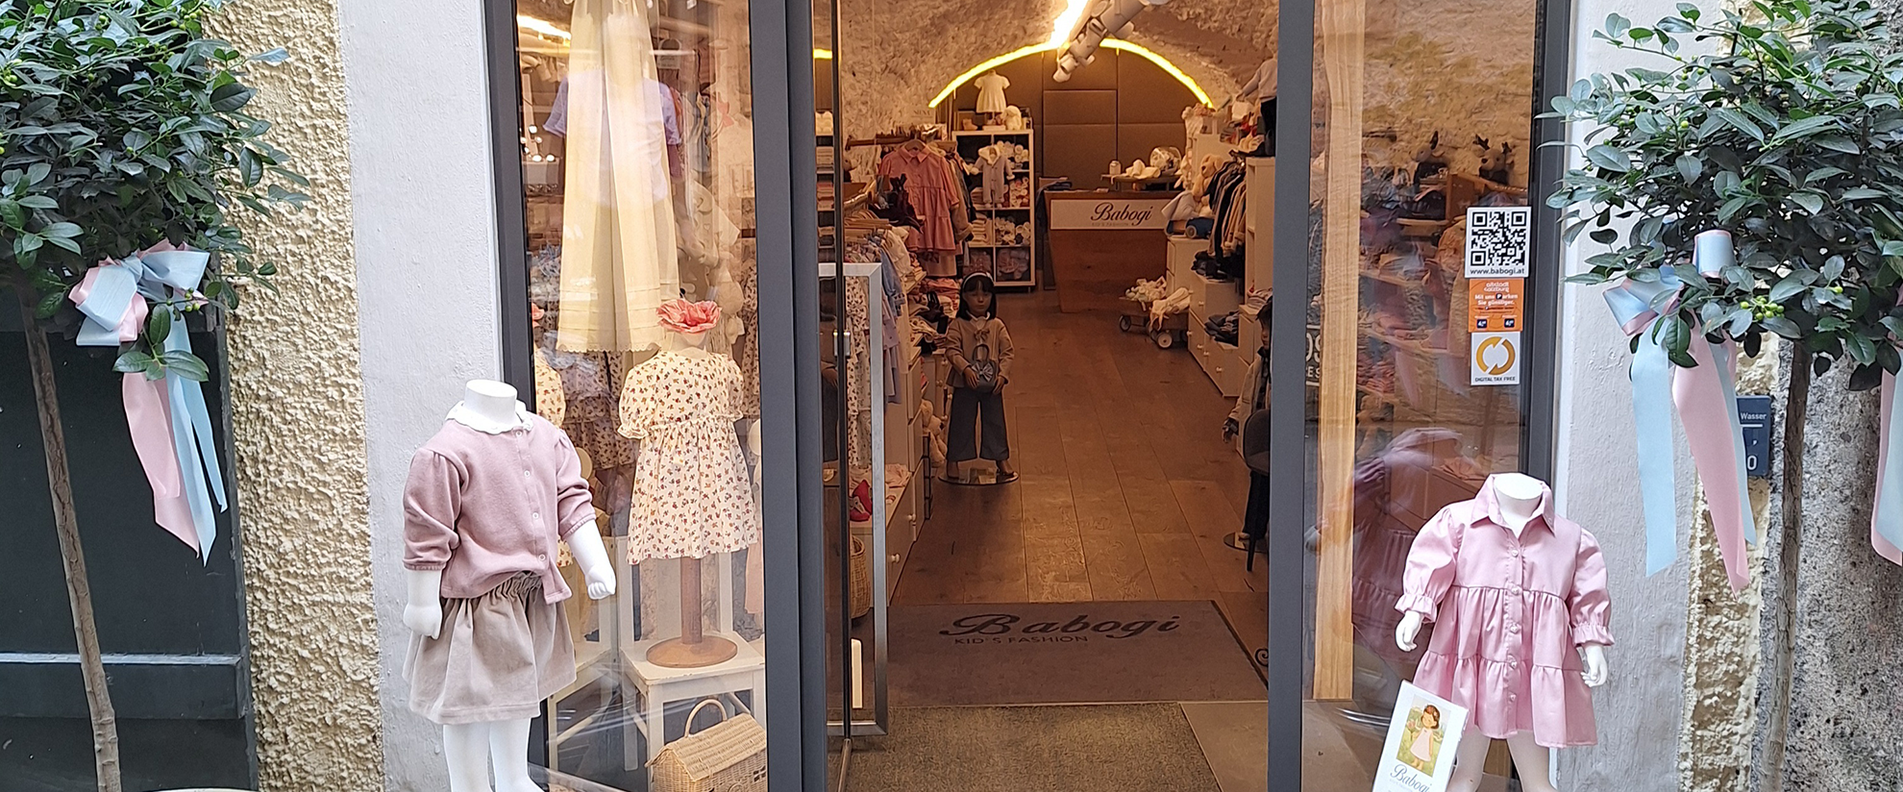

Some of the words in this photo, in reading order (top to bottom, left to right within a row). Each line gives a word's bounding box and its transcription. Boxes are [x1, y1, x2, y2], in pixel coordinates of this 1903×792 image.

[1090, 202, 1154, 226] Babogi
[1470, 267, 1525, 275] www.babogi.at
[1740, 412, 1767, 420] Wasser
[939, 613, 1180, 639] Babogi
[1009, 635, 1089, 644] FASHION
